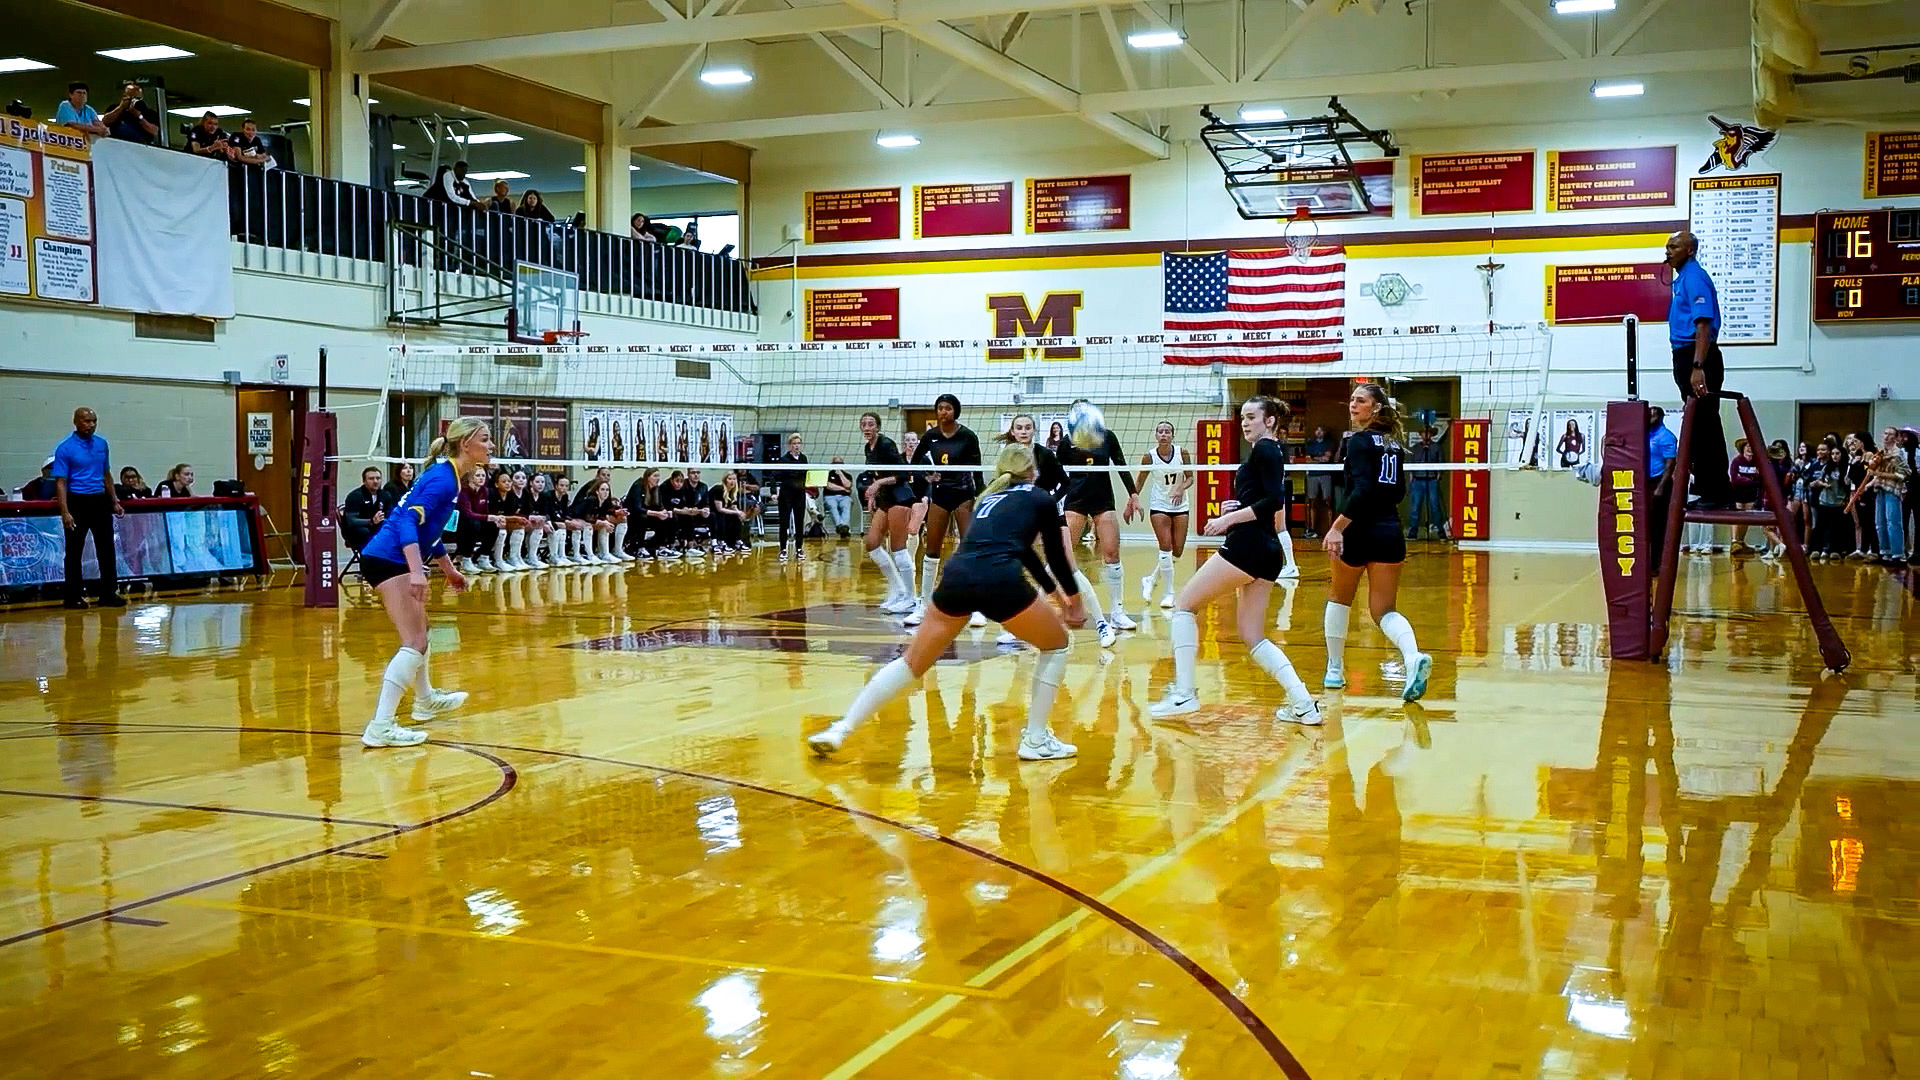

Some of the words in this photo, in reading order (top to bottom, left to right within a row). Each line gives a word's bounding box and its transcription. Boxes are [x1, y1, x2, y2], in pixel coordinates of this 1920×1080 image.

[1424, 159, 1456, 167] CATHOLIC
[1457, 157, 1483, 165] LEAGUE
[1560, 164, 1594, 172] REGIONAL
[1595, 162, 1637, 170] CHAMPIONS
[1423, 181, 1454, 189] NATIONAL
[1456, 179, 1502, 187] SEMIFINALIST
[1594, 180, 1635, 188] CHAMPIONS
[1594, 194, 1625, 202] RESERVE
[1627, 192, 1668, 200] CHAMPIONS
[1833, 216, 1870, 230] HOME
[43, 241, 82, 256] Champion
[1847, 231, 1872, 259] 16
[1833, 278, 1863, 288] FOULS
[1837, 310, 1854, 318] WON
[986, 290, 1084, 362] M
[469, 346, 489, 354] MERCY
[507, 346, 529, 354] MERCY
[547, 346, 568, 354] MERCY
[670, 345, 692, 353] MERCY
[713, 344, 735, 352] MERCY
[756, 344, 779, 352] MERCY
[800, 343, 824, 351] MERCY
[845, 342, 870, 350] MERCY
[892, 341, 916, 349] MERCY
[939, 340, 964, 348] MERCY
[987, 339, 1013, 347] MERCY
[1036, 338, 1062, 346] MERCY
[1086, 336, 1113, 345] MERCY
[1137, 335, 1165, 344] MERCY
[1189, 333, 1217, 342] MERCY
[1243, 332, 1271, 341] MERCY
[1297, 329, 1326, 339] MERCY
[1353, 327, 1382, 337] MERCY
[1410, 324, 1440, 334] MERCY
[542, 427, 560, 439] HOME
[541, 445, 549, 455] OF
[549, 445, 561, 455] THE
[941, 453, 949, 464] 4
[1206, 424, 1222, 521] MARLIN
[1378, 453, 1397, 484] 11
[1164, 473, 1177, 485] 17
[1463, 424, 1481, 537] MARLINS
[301, 462, 312, 543] MERCY
[976, 494, 1009, 519] 7
[1612, 470, 1635, 576] MERCY
[322, 551, 332, 588] Senoh
